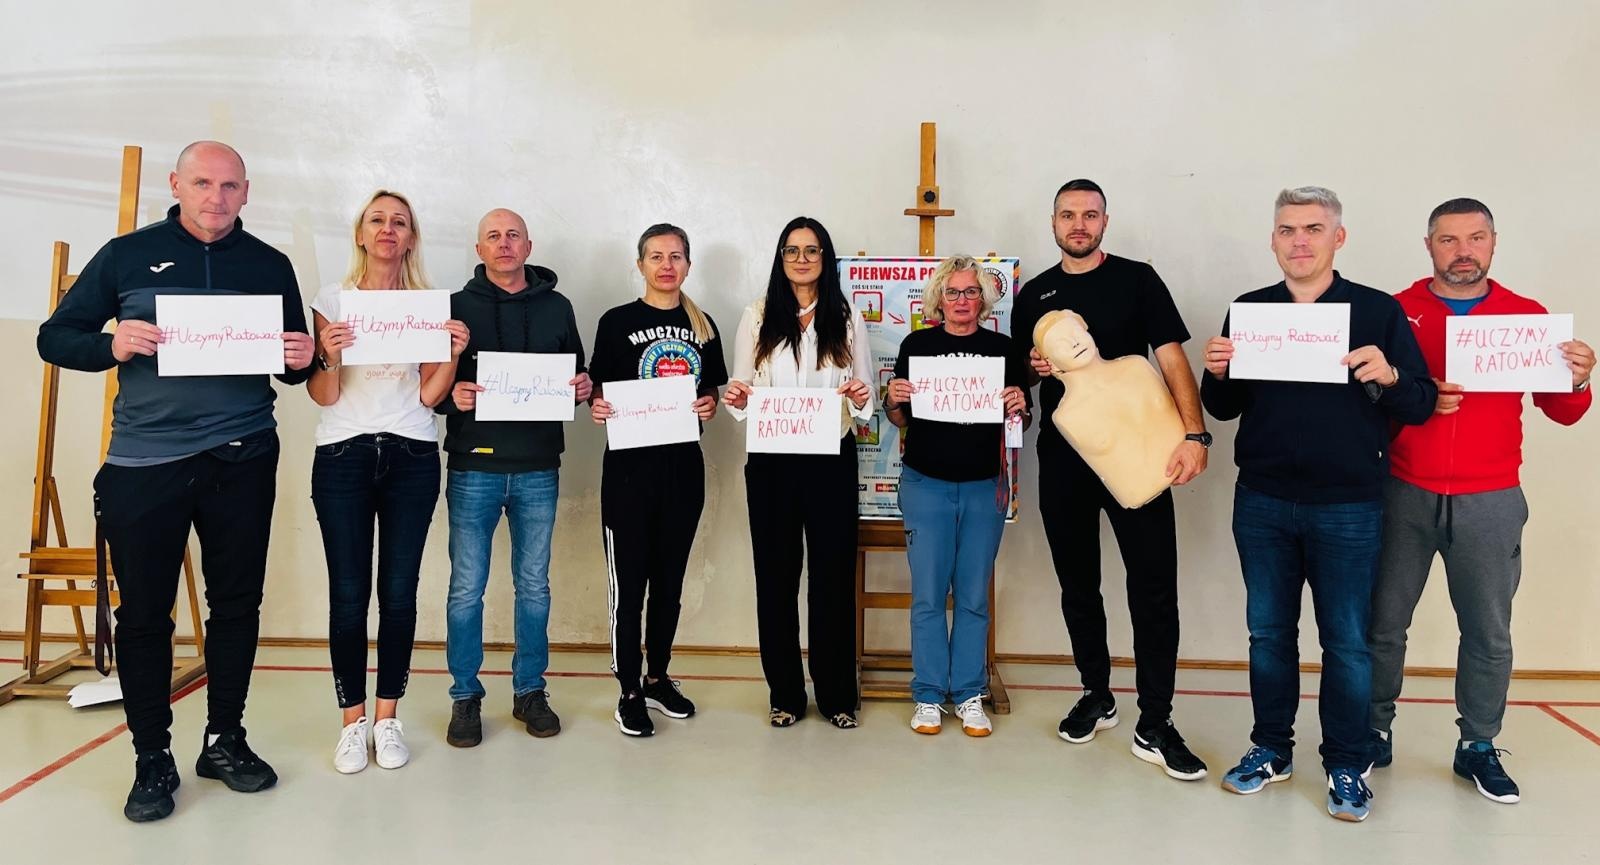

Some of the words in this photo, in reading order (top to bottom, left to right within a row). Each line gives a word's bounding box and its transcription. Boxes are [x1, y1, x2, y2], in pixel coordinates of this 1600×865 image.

[850, 266, 916, 281] PIERWSZA
[1232, 330, 1282, 352] #Uczymy
[1287, 327, 1341, 345] Ratować
[1456, 327, 1548, 349] #UCZYMY
[1474, 345, 1553, 375] RATOWAĆ
[917, 376, 986, 393] #UCZYMY
[760, 397, 823, 414] #UCZYMY
[933, 388, 999, 412] RATOWAĆ
[757, 415, 815, 439] RATOWAĆ
